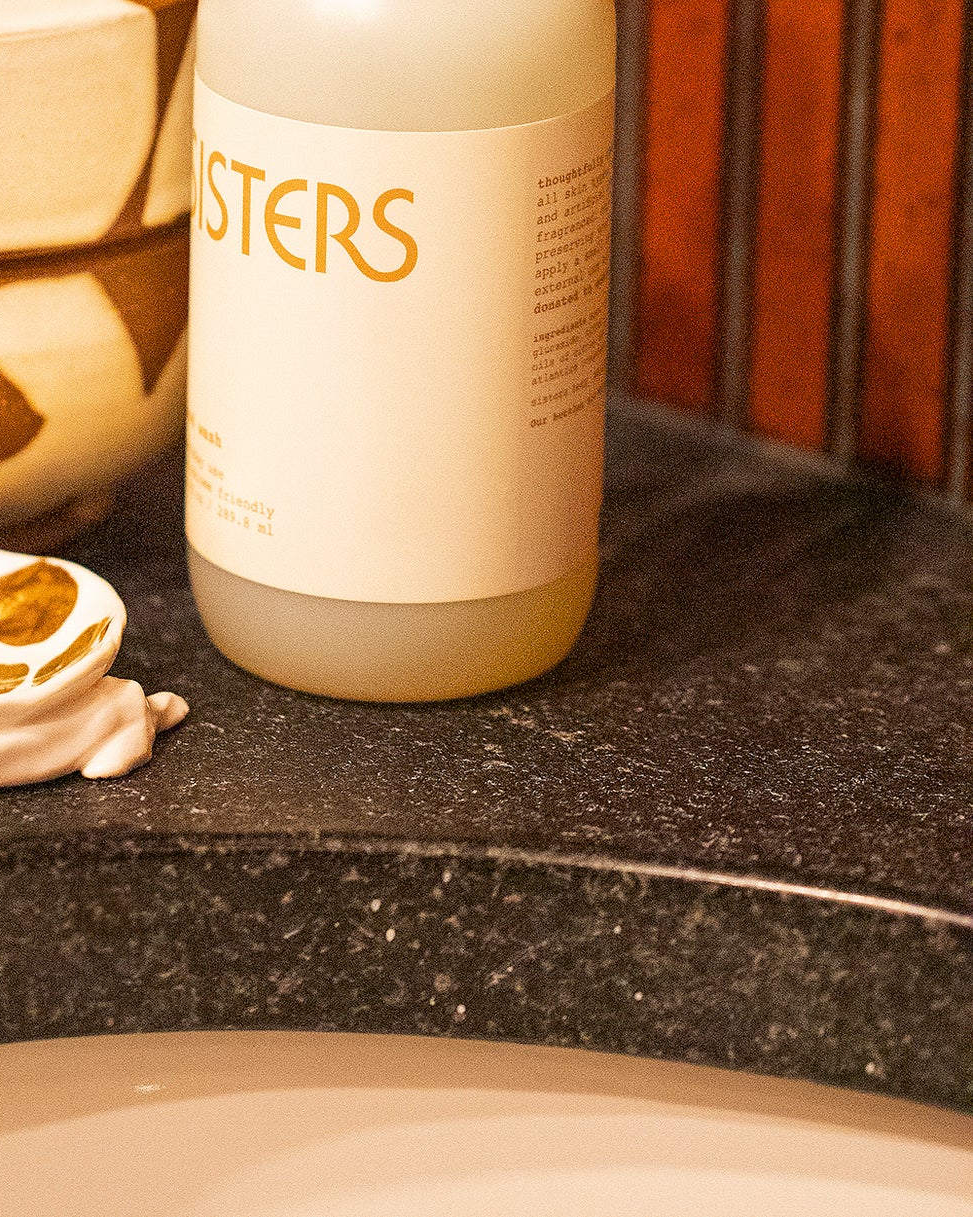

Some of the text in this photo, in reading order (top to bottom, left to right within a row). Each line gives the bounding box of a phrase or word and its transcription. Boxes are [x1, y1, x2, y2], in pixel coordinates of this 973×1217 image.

[537, 192, 558, 207] all
[537, 209, 558, 225] and
[535, 261, 568, 281] apply
[534, 290, 579, 314] donated
[218, 487, 275, 520] friendly
[257, 524, 274, 537] ml
